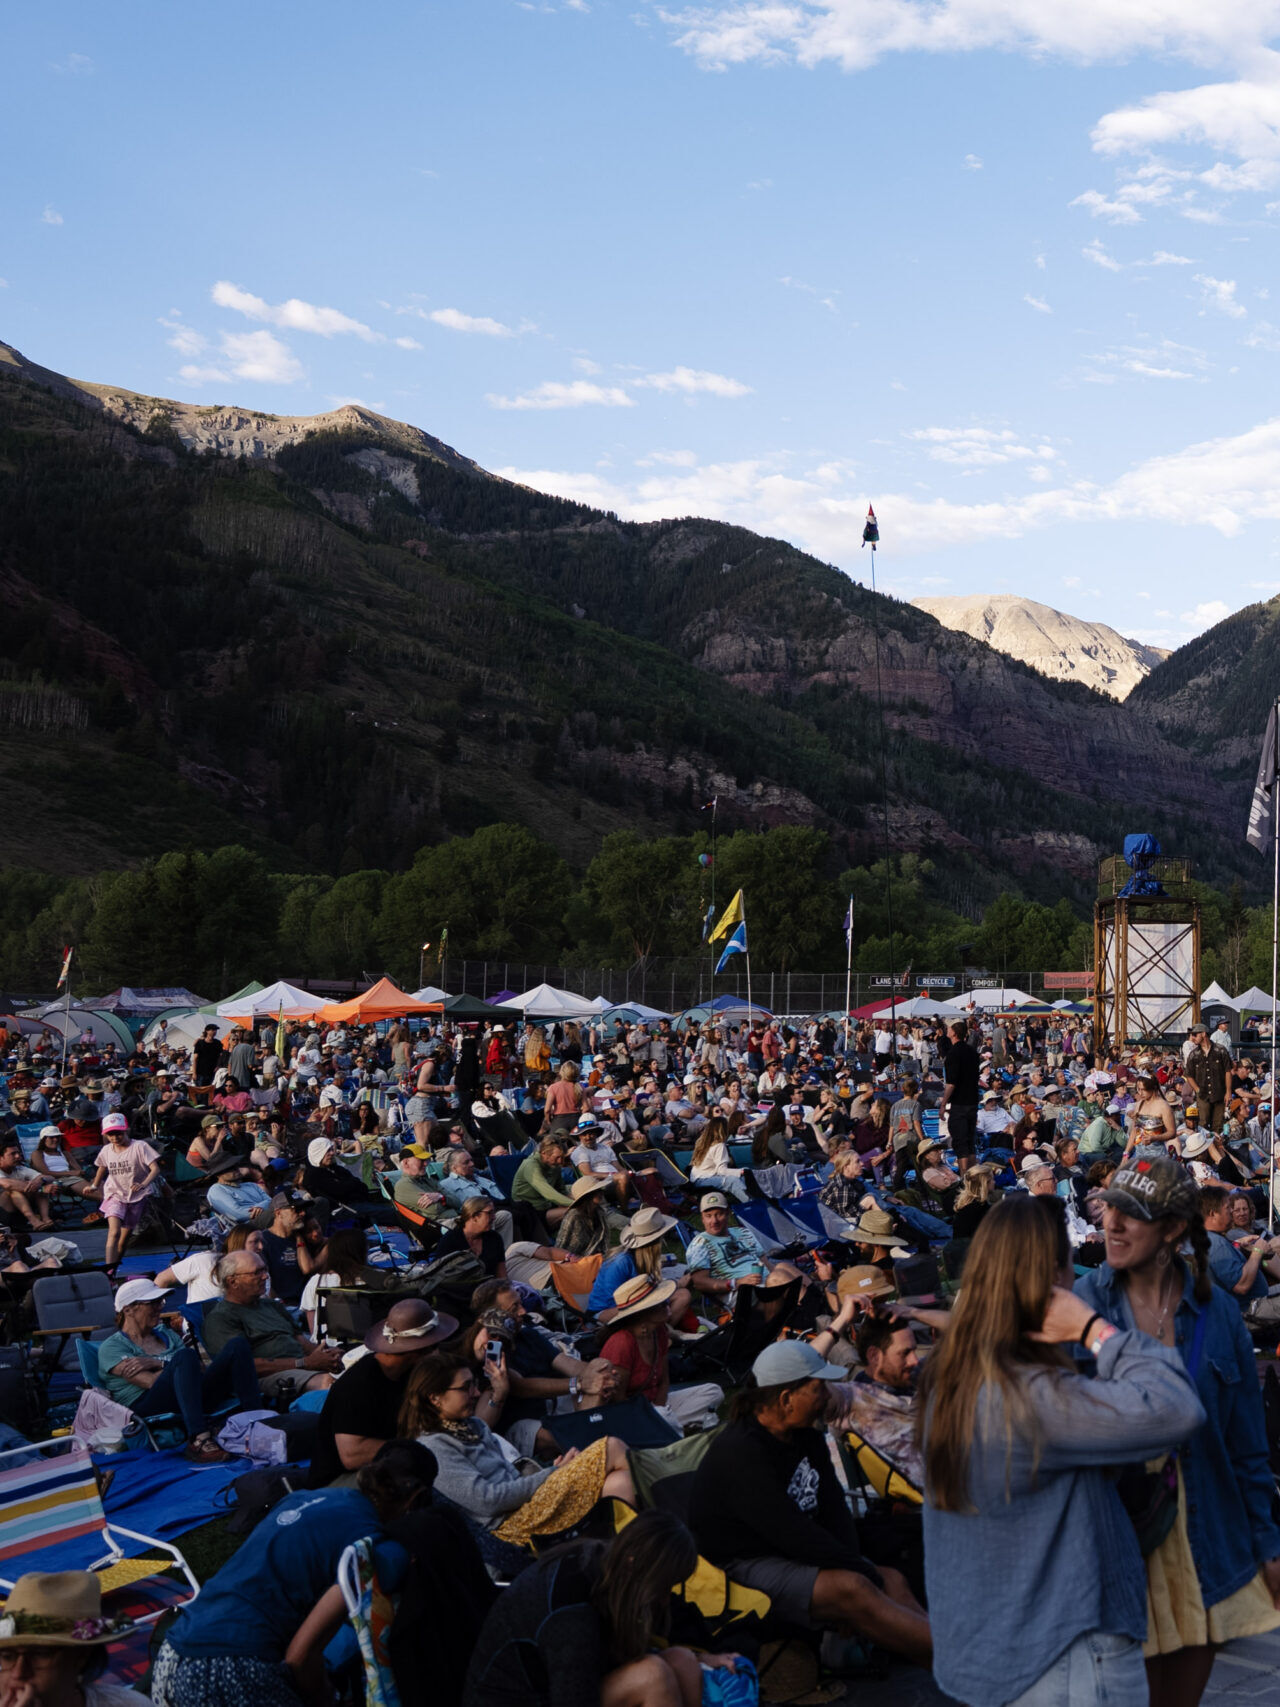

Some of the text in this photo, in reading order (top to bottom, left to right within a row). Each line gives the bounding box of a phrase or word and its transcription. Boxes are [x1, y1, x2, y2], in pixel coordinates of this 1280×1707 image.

[971, 979, 998, 987] COMPOST
[118, 1160, 129, 1168] NOT
[1131, 1173, 1157, 1195] LEG
